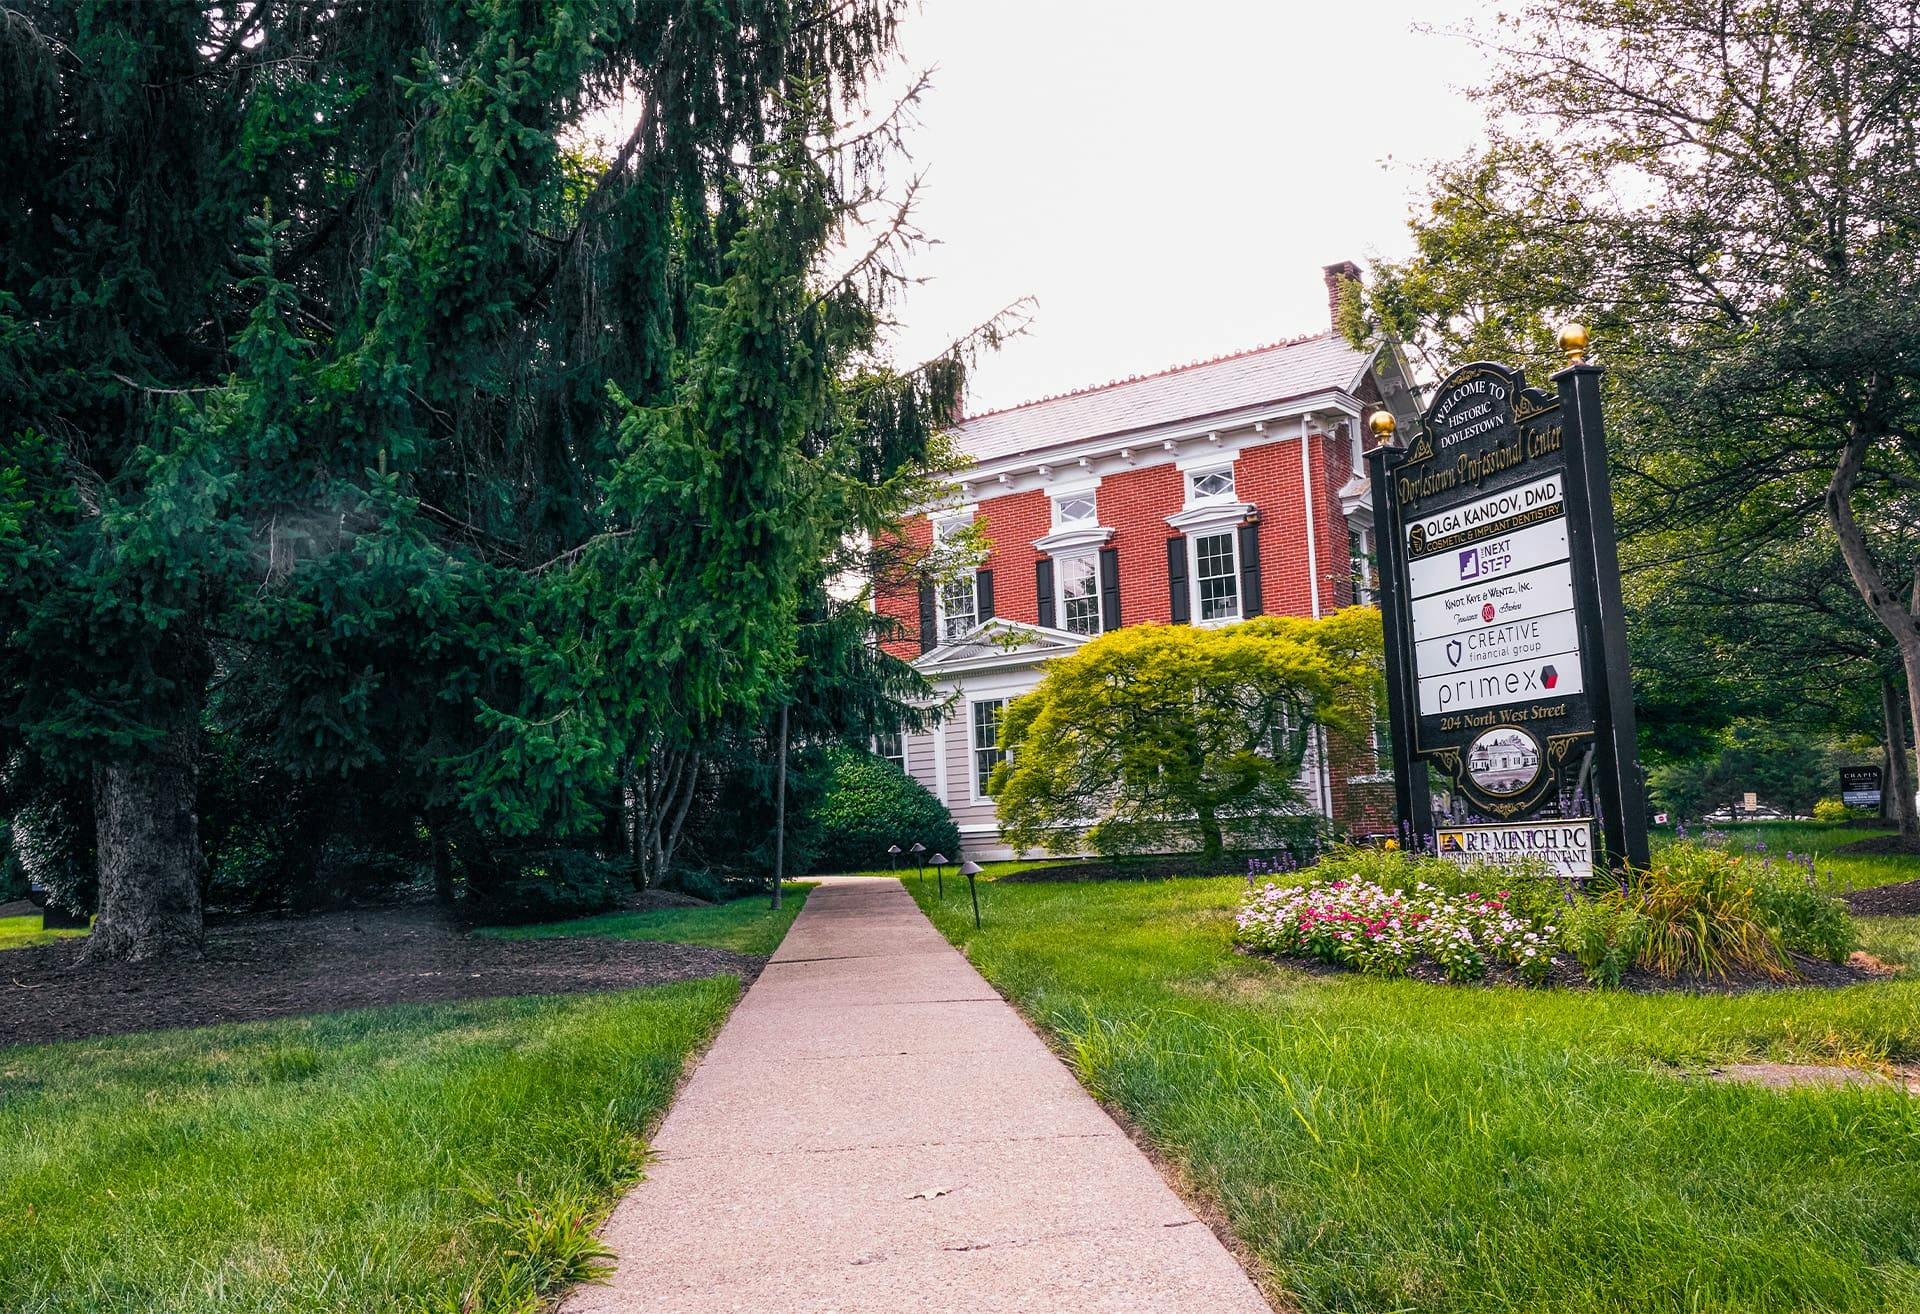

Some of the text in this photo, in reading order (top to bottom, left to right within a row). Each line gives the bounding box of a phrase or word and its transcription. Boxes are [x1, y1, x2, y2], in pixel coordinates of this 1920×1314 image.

[1434, 380, 1505, 425] WELCOME TO
[1448, 401, 1493, 428] HISTORIC
[1441, 414, 1504, 449] DOYLESTOWN
[1399, 424, 1563, 510] Doylestown Professional Center
[1427, 483, 1556, 537] OLGA KANDOV, DMD
[1426, 503, 1560, 552] COSMETIC & IMPLANT DENTISTRY
[1484, 539, 1511, 557] NEXT
[1481, 554, 1512, 575] STEP
[1467, 621, 1540, 650] CREATIVE
[1469, 642, 1542, 663] financial group
[1438, 669, 1537, 712] primex
[1440, 703, 1566, 732] 204 North West Street
[1493, 829, 1559, 851] MINICH
[1562, 827, 1587, 849] PC
